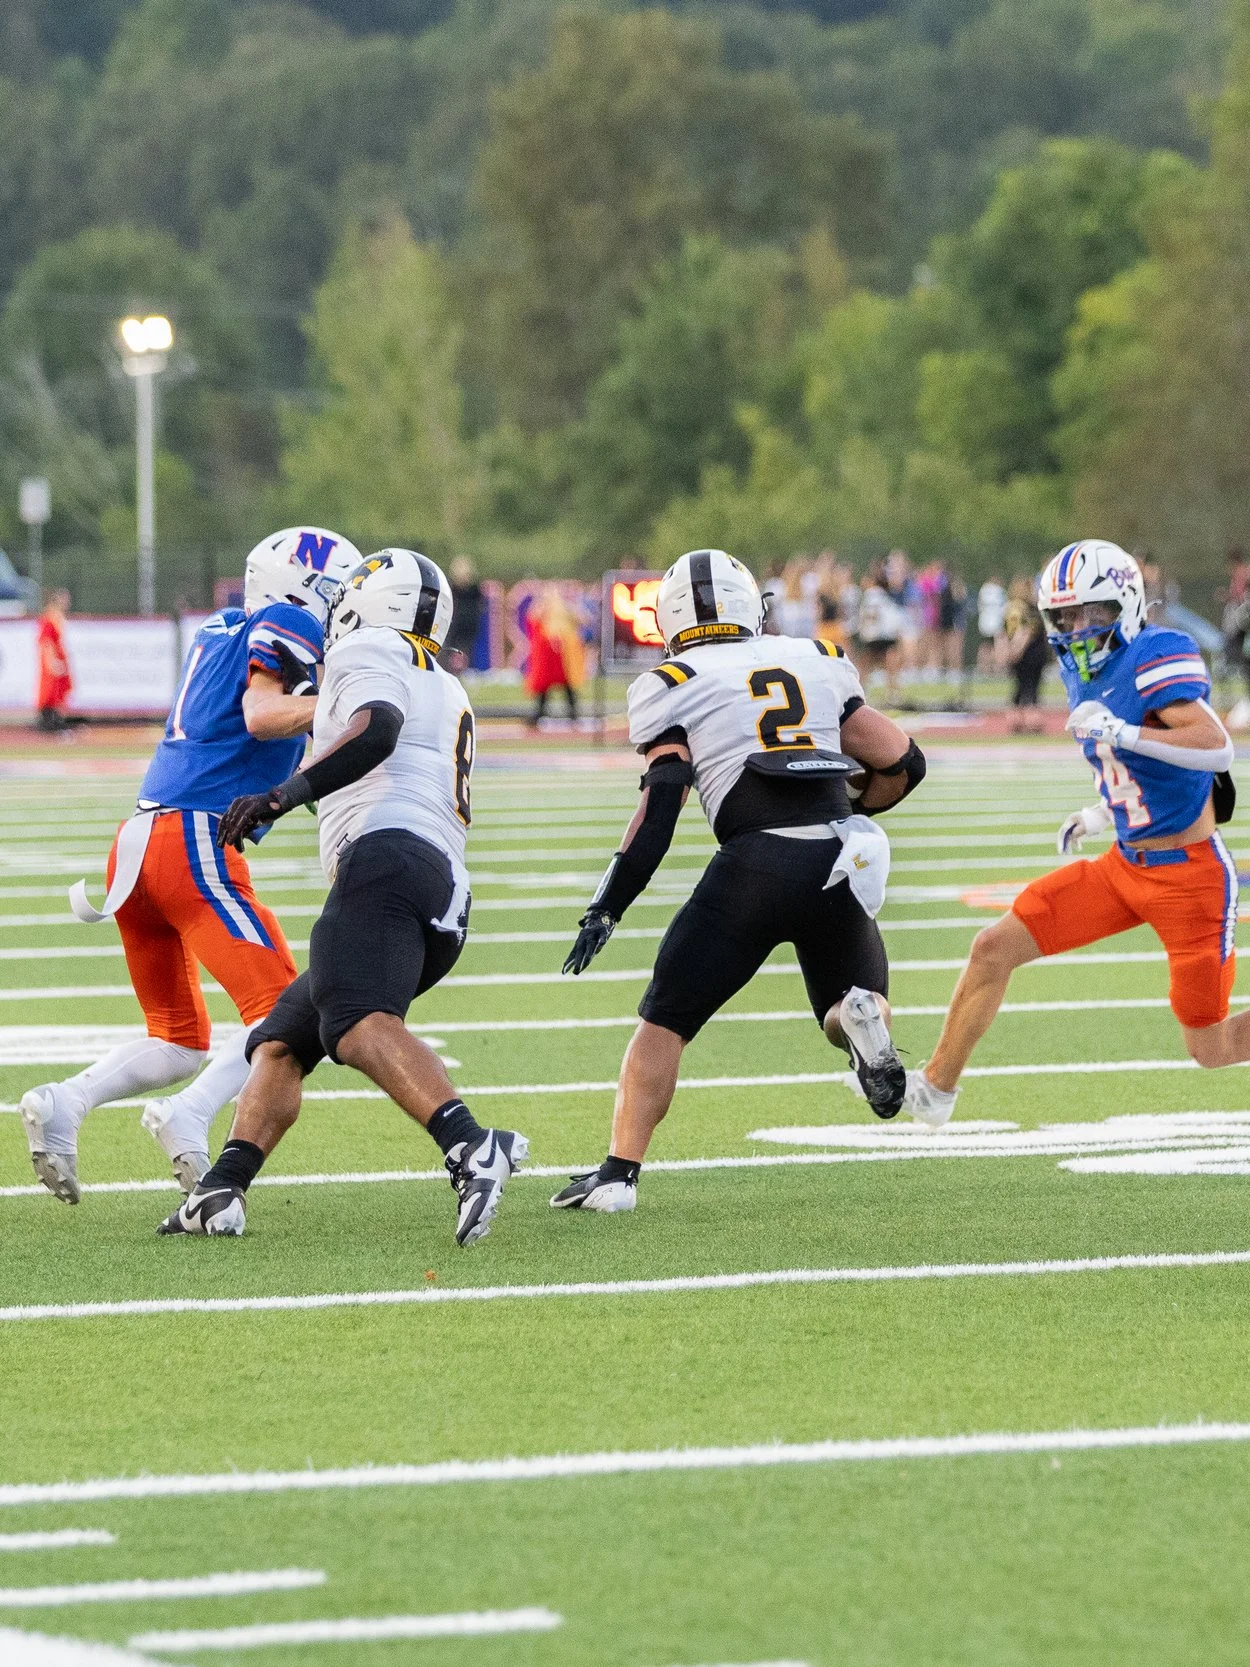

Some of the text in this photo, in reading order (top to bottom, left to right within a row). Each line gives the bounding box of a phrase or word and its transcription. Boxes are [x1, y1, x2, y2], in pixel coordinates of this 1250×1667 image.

[289, 532, 338, 572] N
[747, 667, 816, 751] 2
[454, 707, 476, 826] 8
